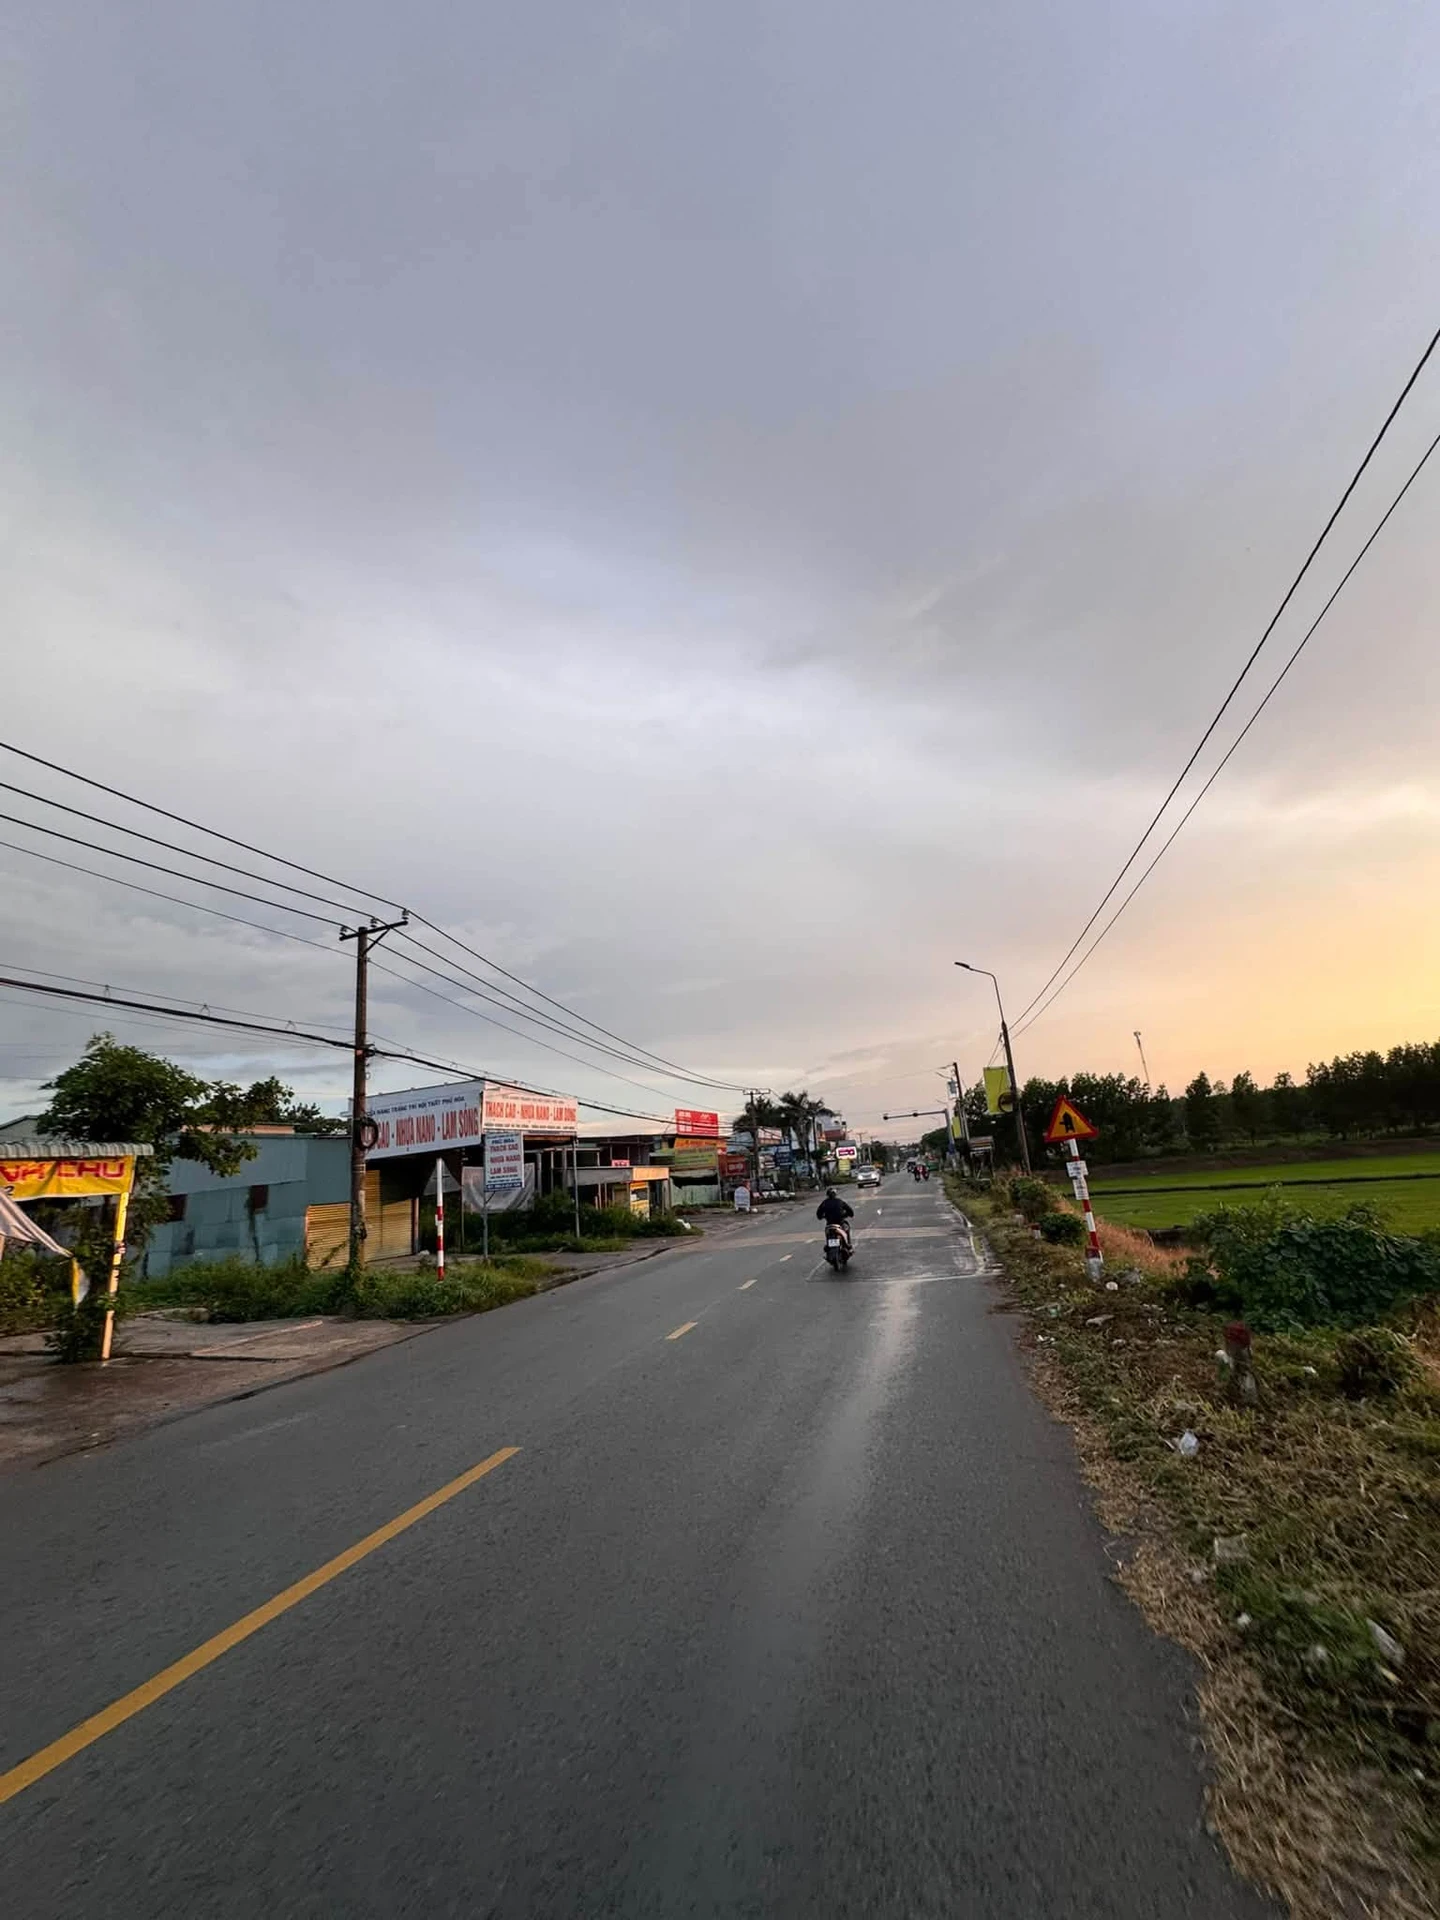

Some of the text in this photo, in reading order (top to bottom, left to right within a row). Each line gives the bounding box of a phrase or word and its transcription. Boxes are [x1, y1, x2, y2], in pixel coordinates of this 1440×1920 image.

[416, 1113, 436, 1144] NANO
[442, 1110, 457, 1140] LAM
[458, 1103, 479, 1138] SÓNG
